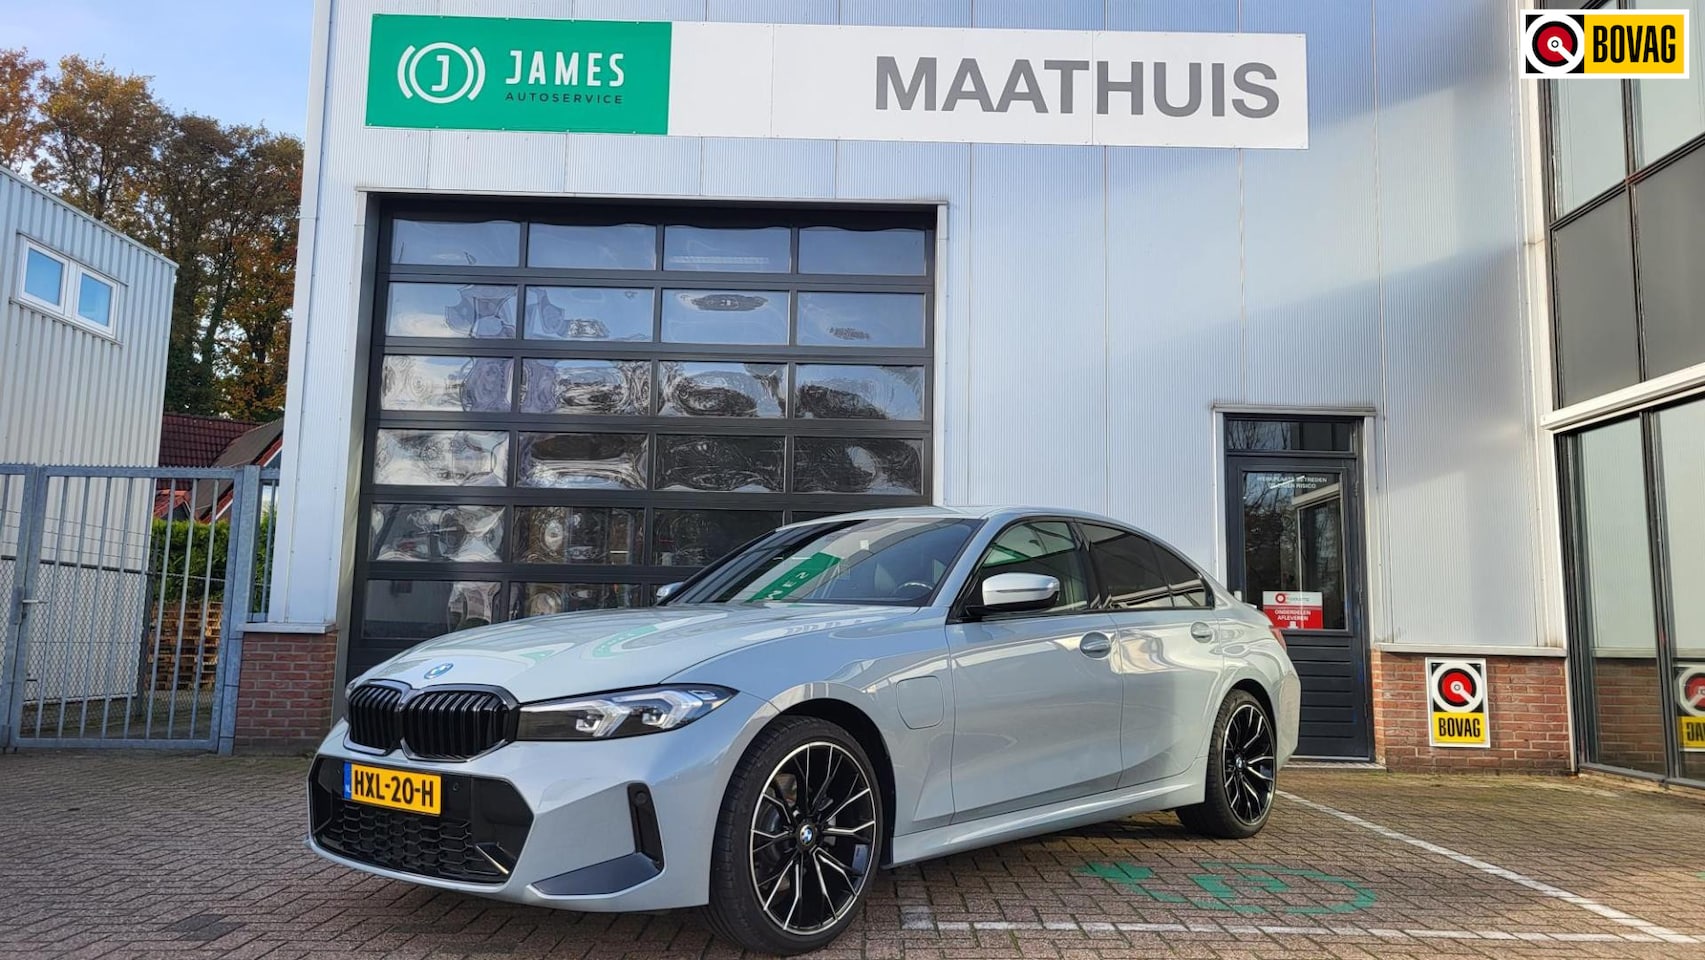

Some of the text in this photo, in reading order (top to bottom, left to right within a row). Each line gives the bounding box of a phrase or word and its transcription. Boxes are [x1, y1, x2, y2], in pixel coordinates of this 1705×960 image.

[505, 50, 625, 87] JAMES
[875, 55, 1280, 118] MAATHUIS
[504, 92, 623, 104] AUTOSERVICE
[1438, 717, 1481, 738] BOVAG
[354, 769, 434, 808] HXL-20-H
